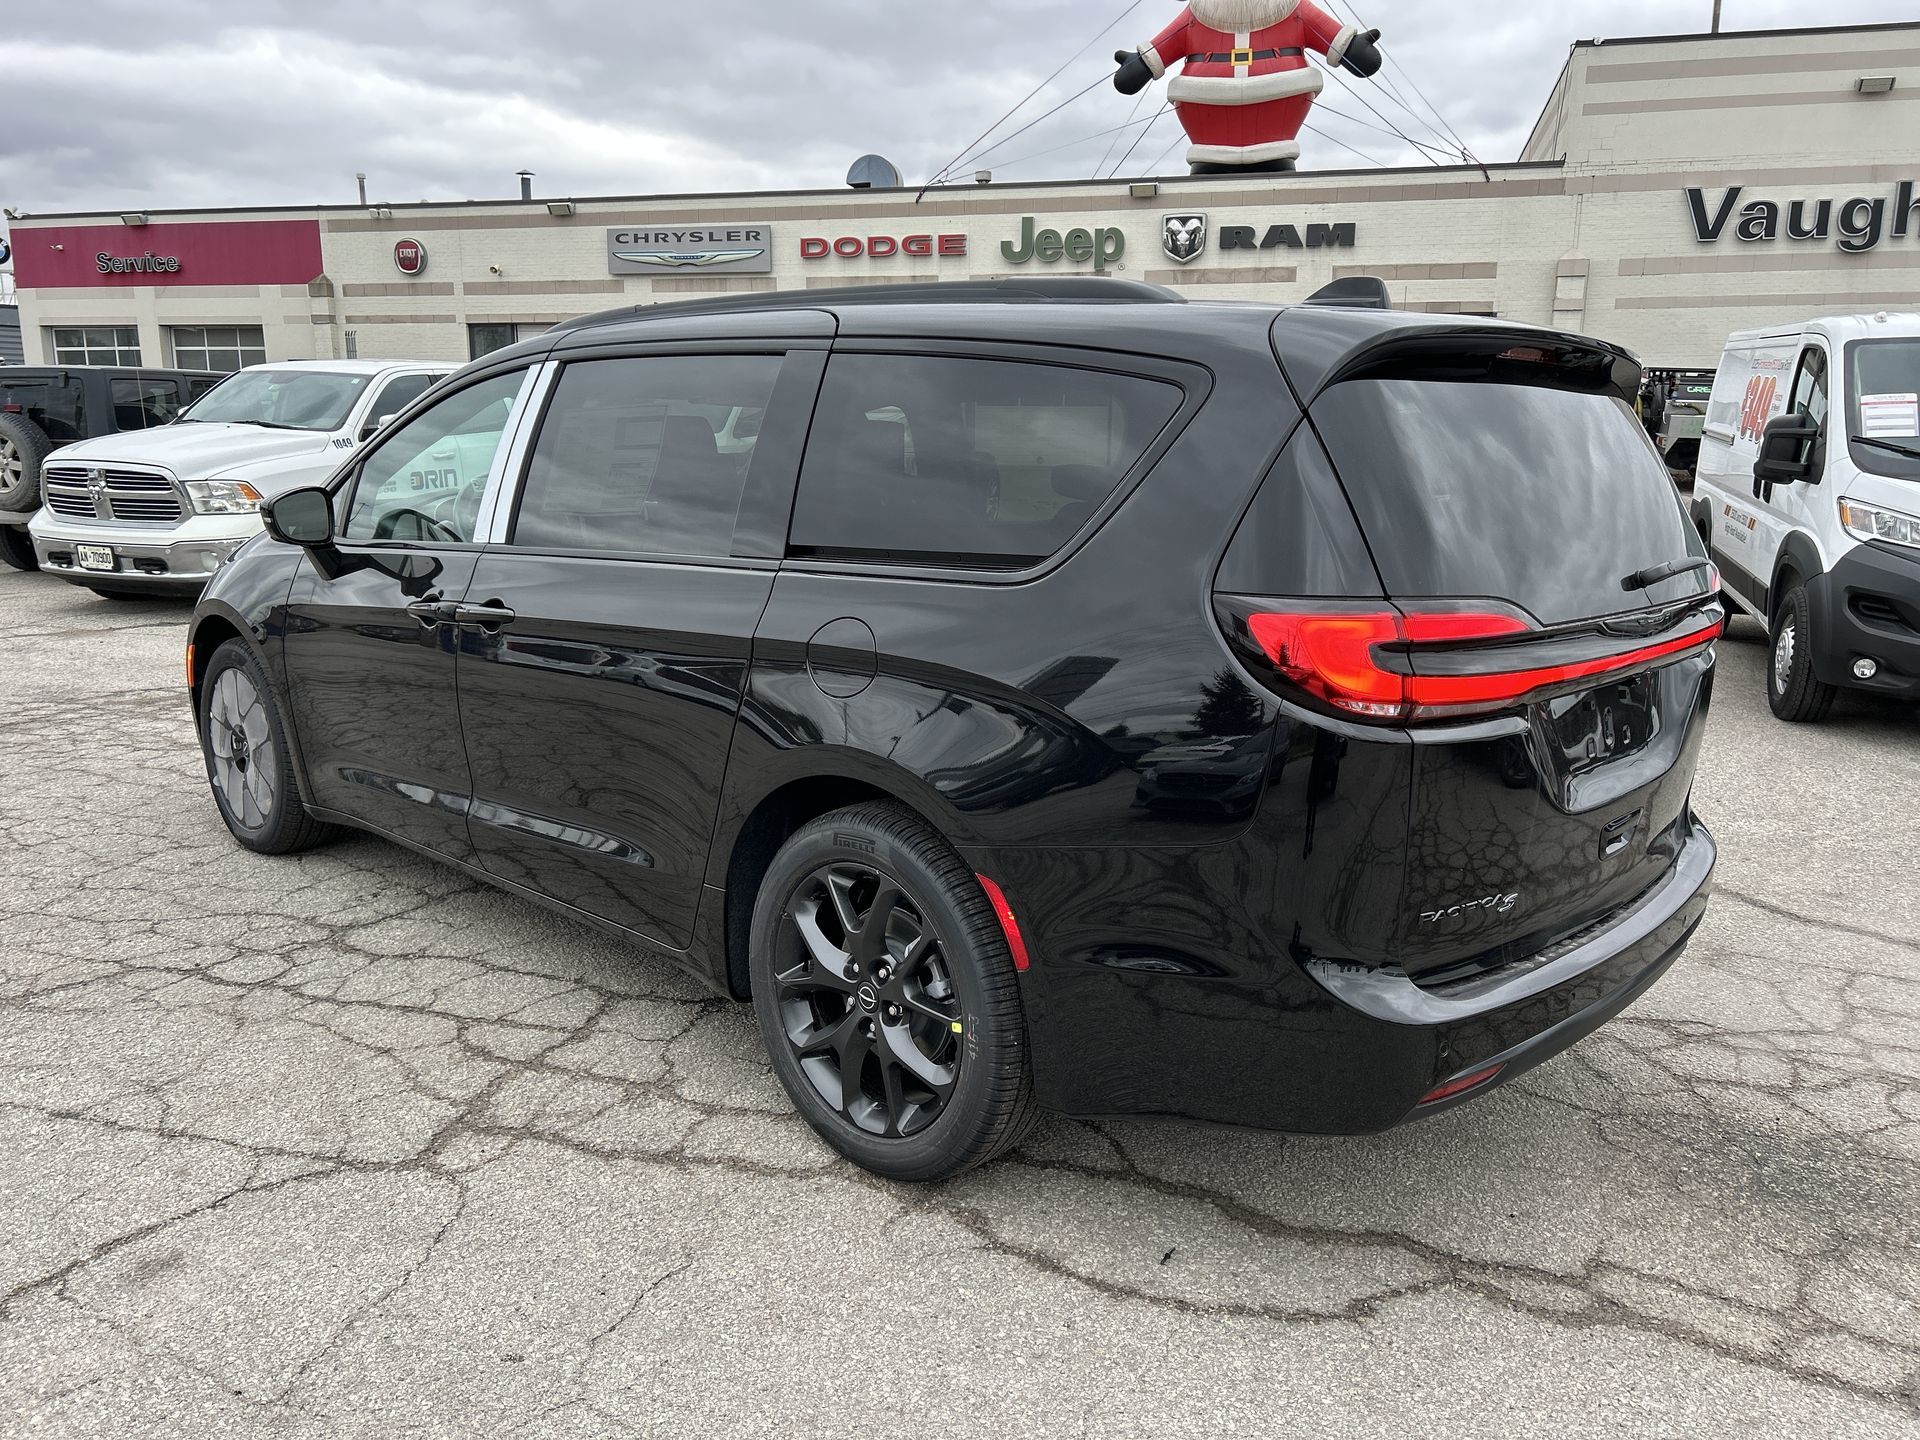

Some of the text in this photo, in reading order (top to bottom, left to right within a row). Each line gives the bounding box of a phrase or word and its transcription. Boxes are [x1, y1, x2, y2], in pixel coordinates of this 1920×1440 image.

[615, 230, 761, 245] CHRYSLER
[801, 234, 968, 258] DODGE
[1001, 216, 1125, 270] Jeep
[1219, 222, 1356, 249] RAM
[96, 251, 179, 273] Service
[332, 437, 354, 449] 1049
[832, 832, 876, 854] PIRELLI
